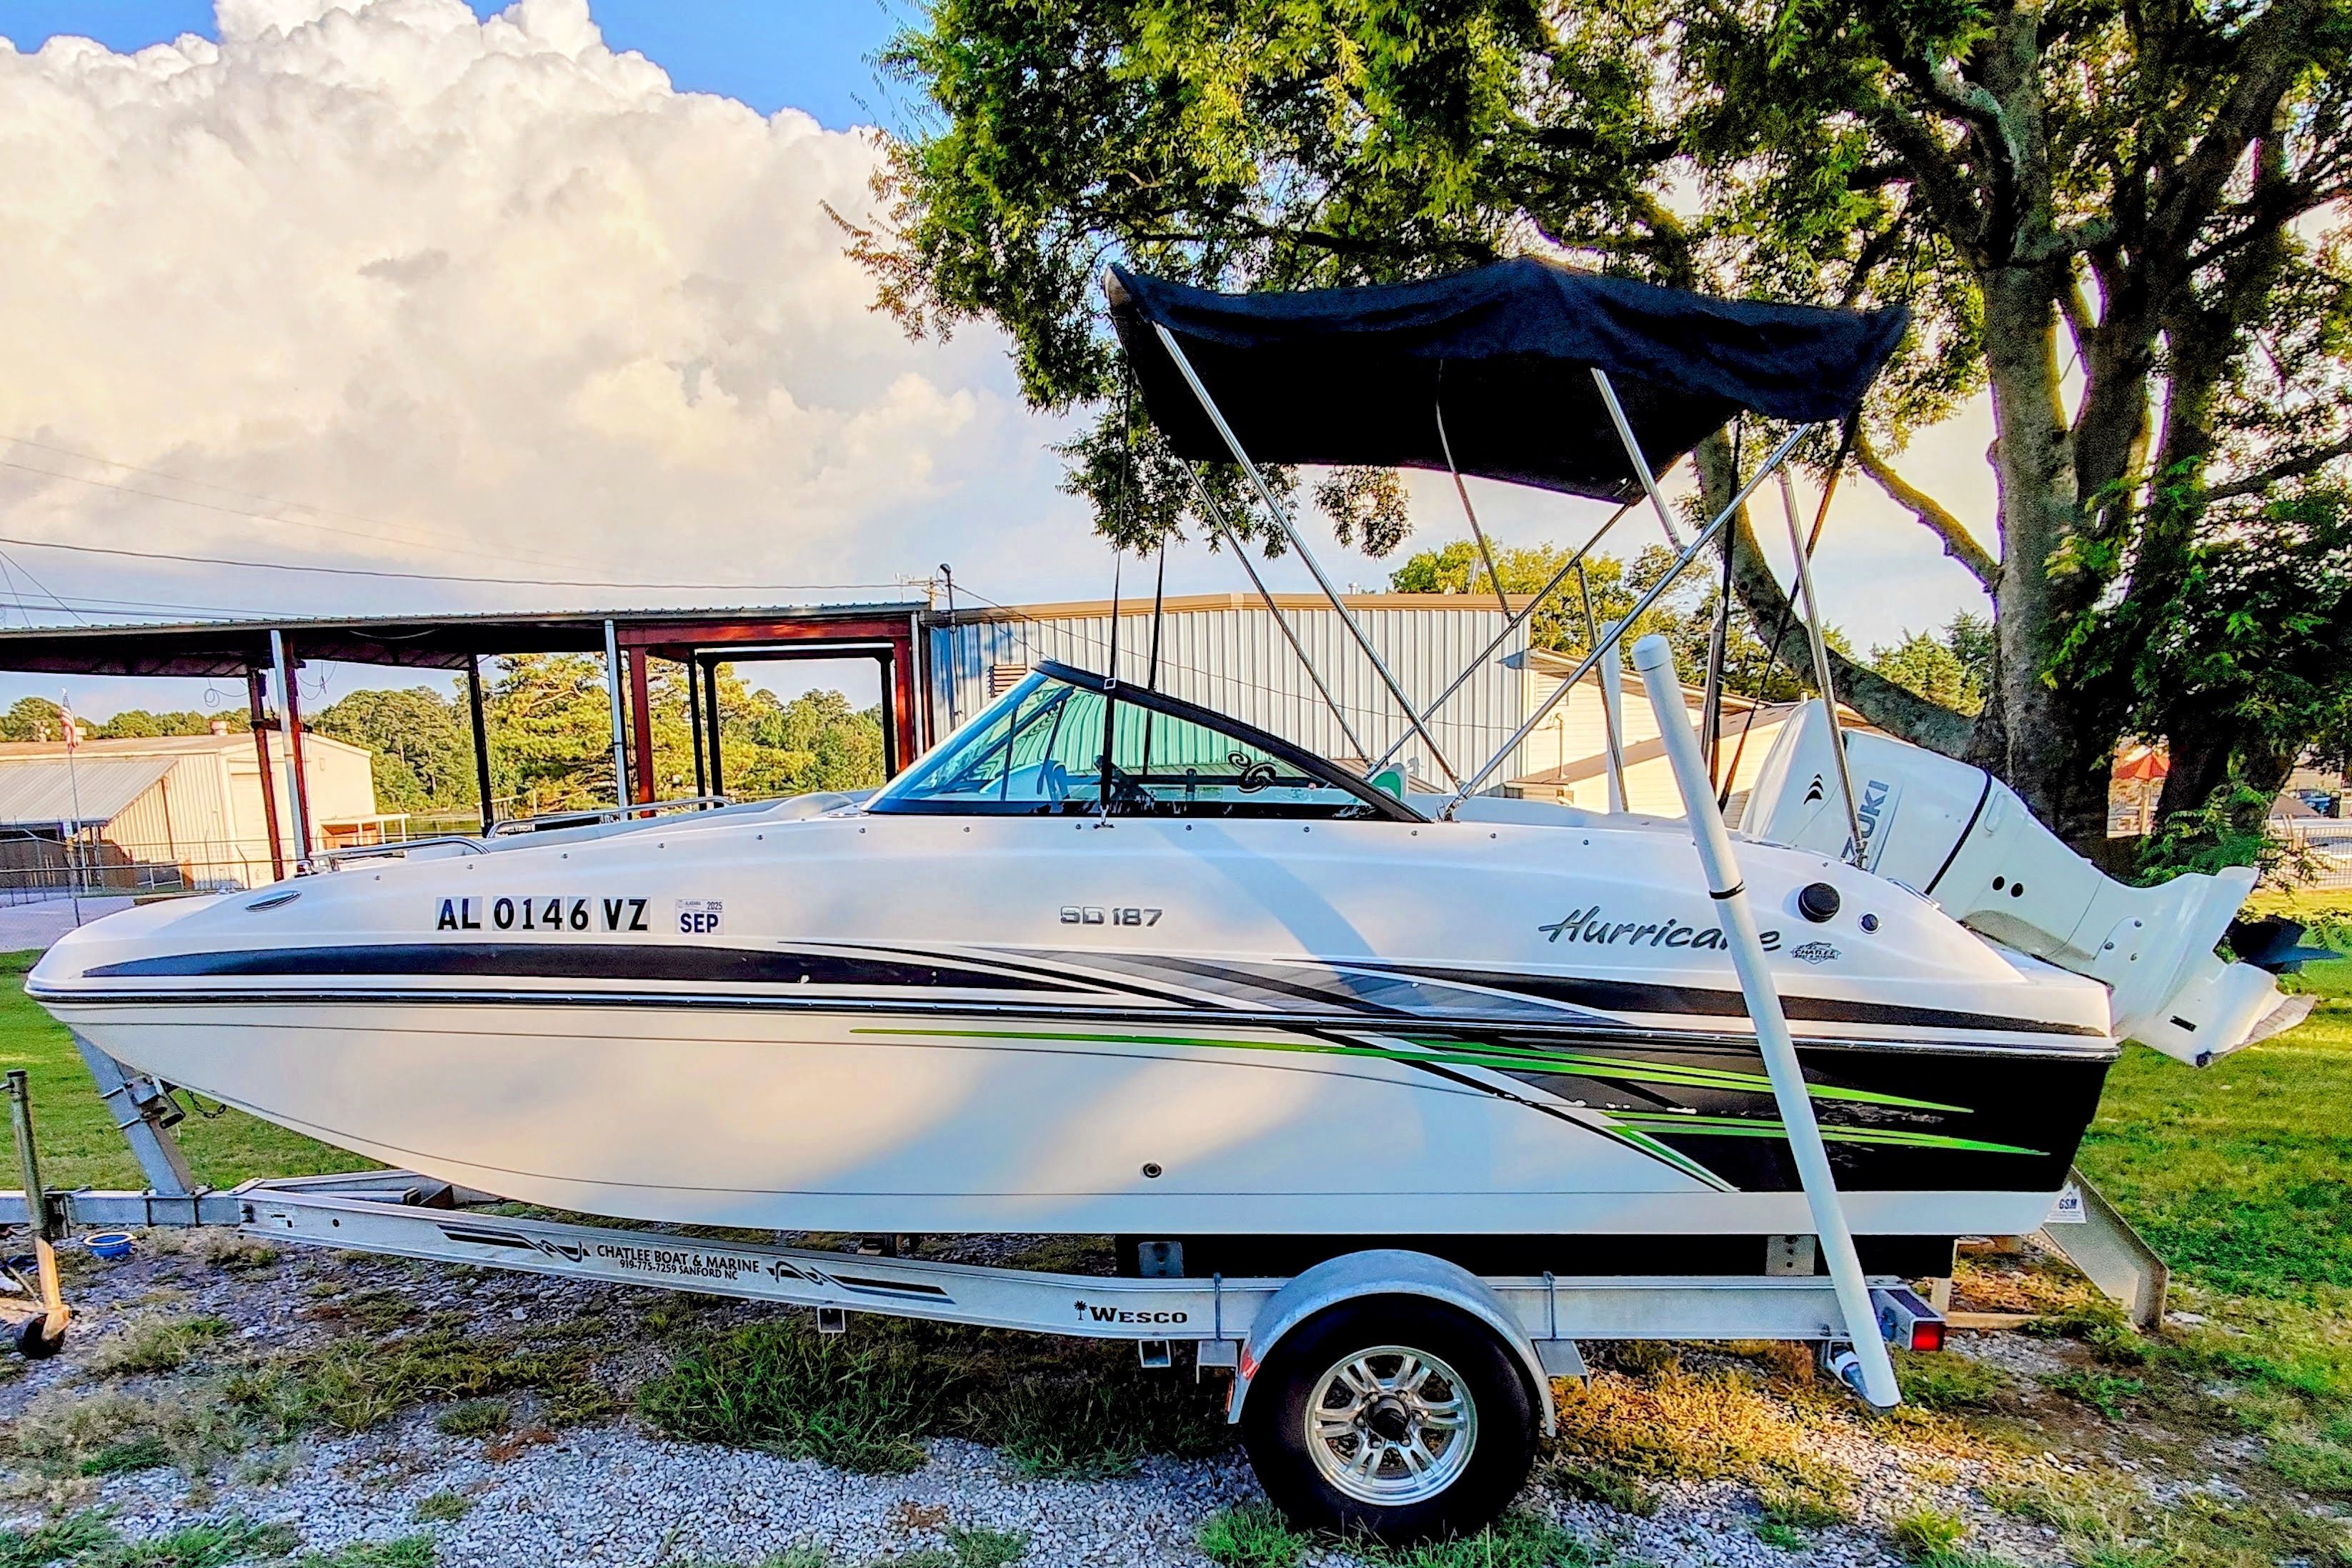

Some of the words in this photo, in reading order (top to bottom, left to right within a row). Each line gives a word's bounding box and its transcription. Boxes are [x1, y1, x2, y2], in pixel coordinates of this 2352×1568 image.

[438, 899, 480, 930] AL
[494, 898, 589, 929] 0146
[604, 899, 648, 931] VZ
[707, 902, 722, 910] 2025
[1060, 906, 1105, 924] SD
[1112, 908, 1162, 927] 187
[680, 913, 719, 933] SEP
[1539, 906, 1780, 952] Hurricae
[597, 1244, 650, 1262] CHATLEE
[654, 1251, 688, 1265] BOAT
[692, 1254, 703, 1267] &
[706, 1256, 759, 1273] MARINE
[620, 1259, 677, 1274] 919-775-7259
[679, 1266, 722, 1278] SANFORD
[724, 1270, 738, 1280] NC
